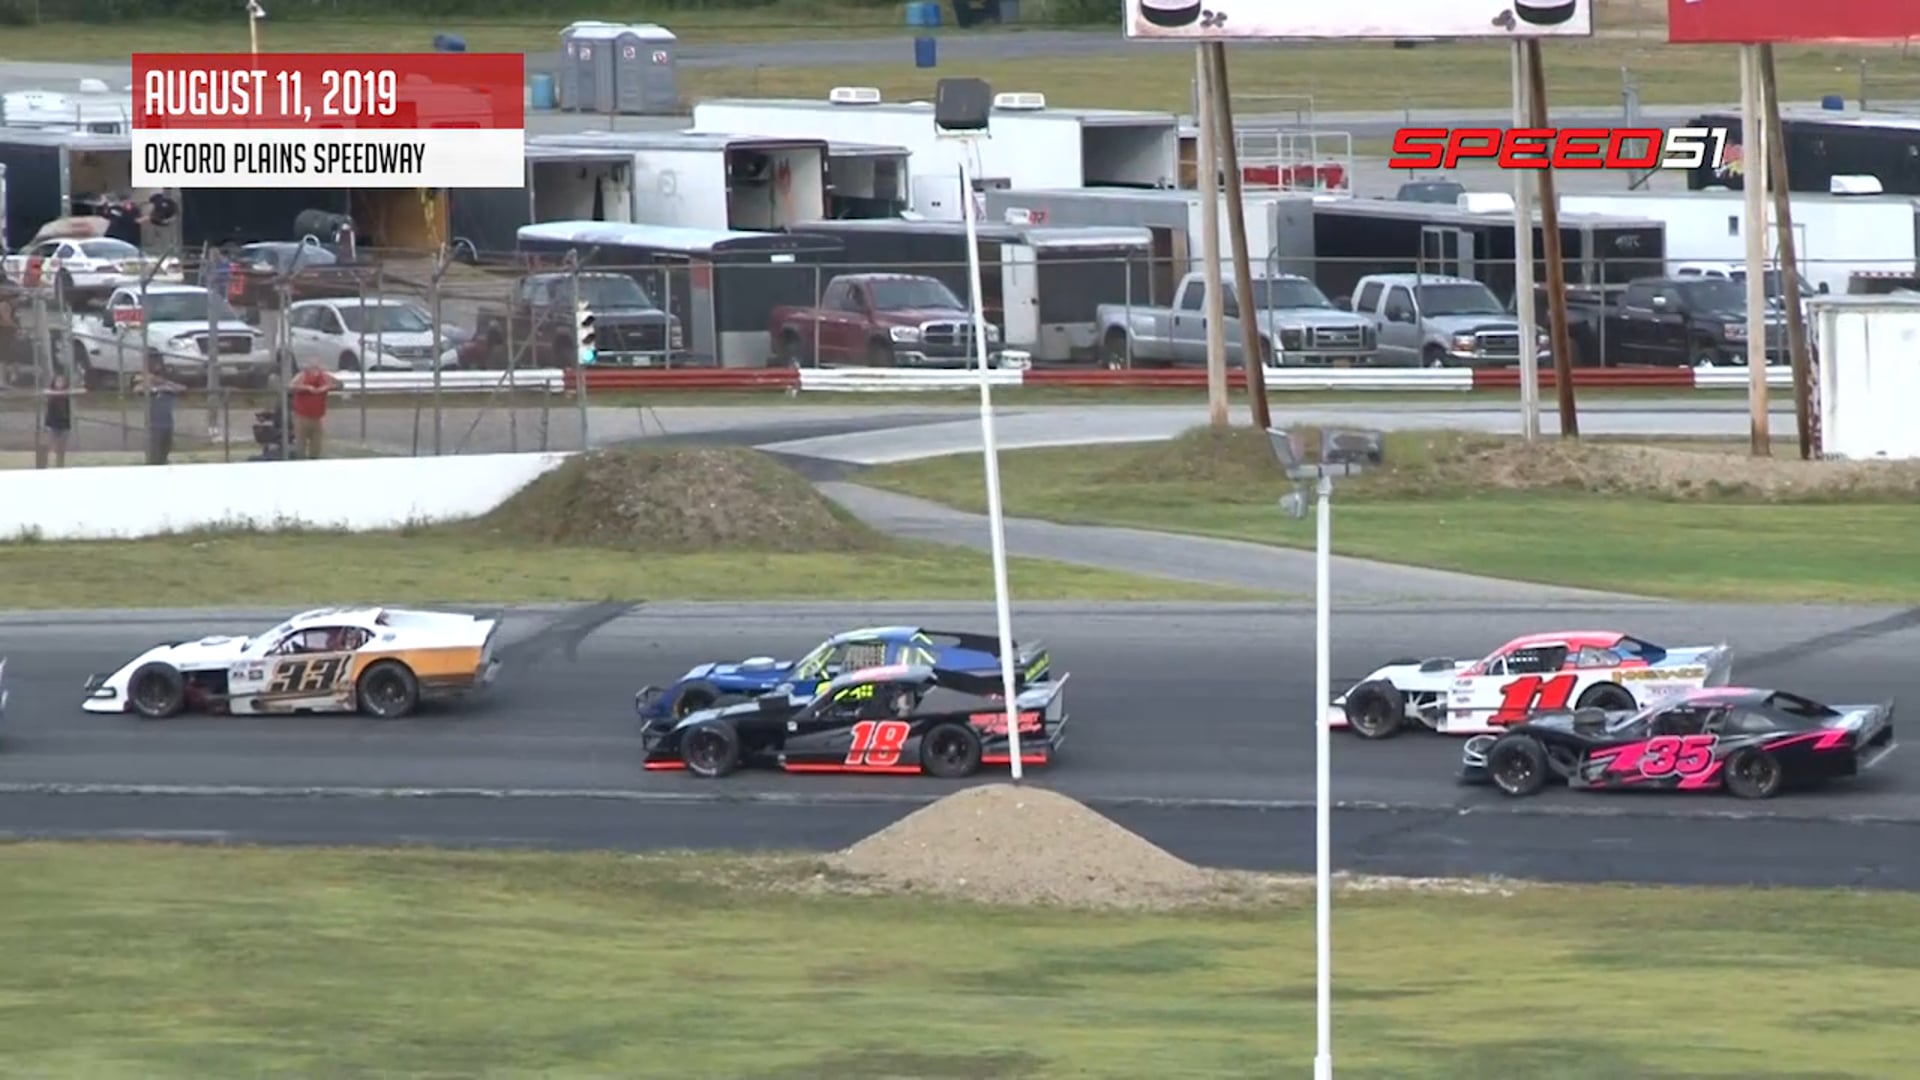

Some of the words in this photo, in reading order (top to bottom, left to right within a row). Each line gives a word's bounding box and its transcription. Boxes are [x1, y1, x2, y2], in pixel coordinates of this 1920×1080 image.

[1487, 674, 1579, 727] 11
[844, 720, 911, 765] 18
[1639, 734, 1720, 778] 35
